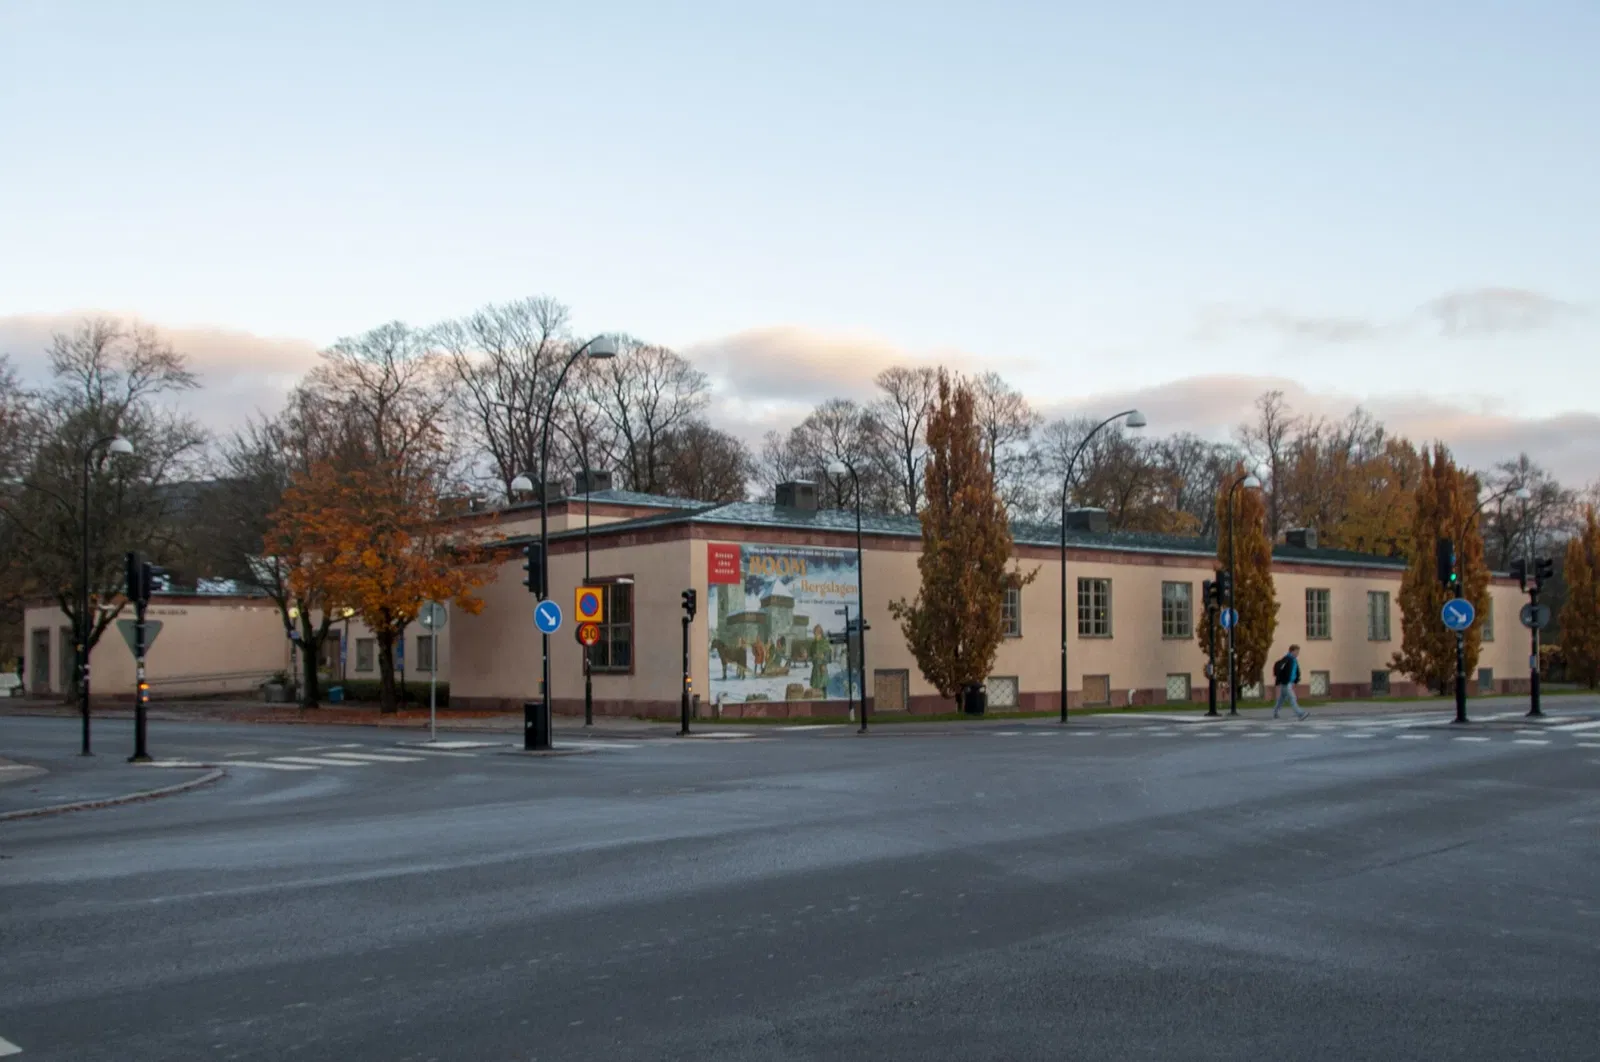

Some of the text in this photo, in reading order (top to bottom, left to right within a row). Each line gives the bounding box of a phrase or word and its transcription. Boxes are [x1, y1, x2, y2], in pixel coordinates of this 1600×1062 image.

[749, 555, 807, 577] BOOM
[801, 579, 857, 598] Bergslagen
[584, 627, 596, 640] 30
